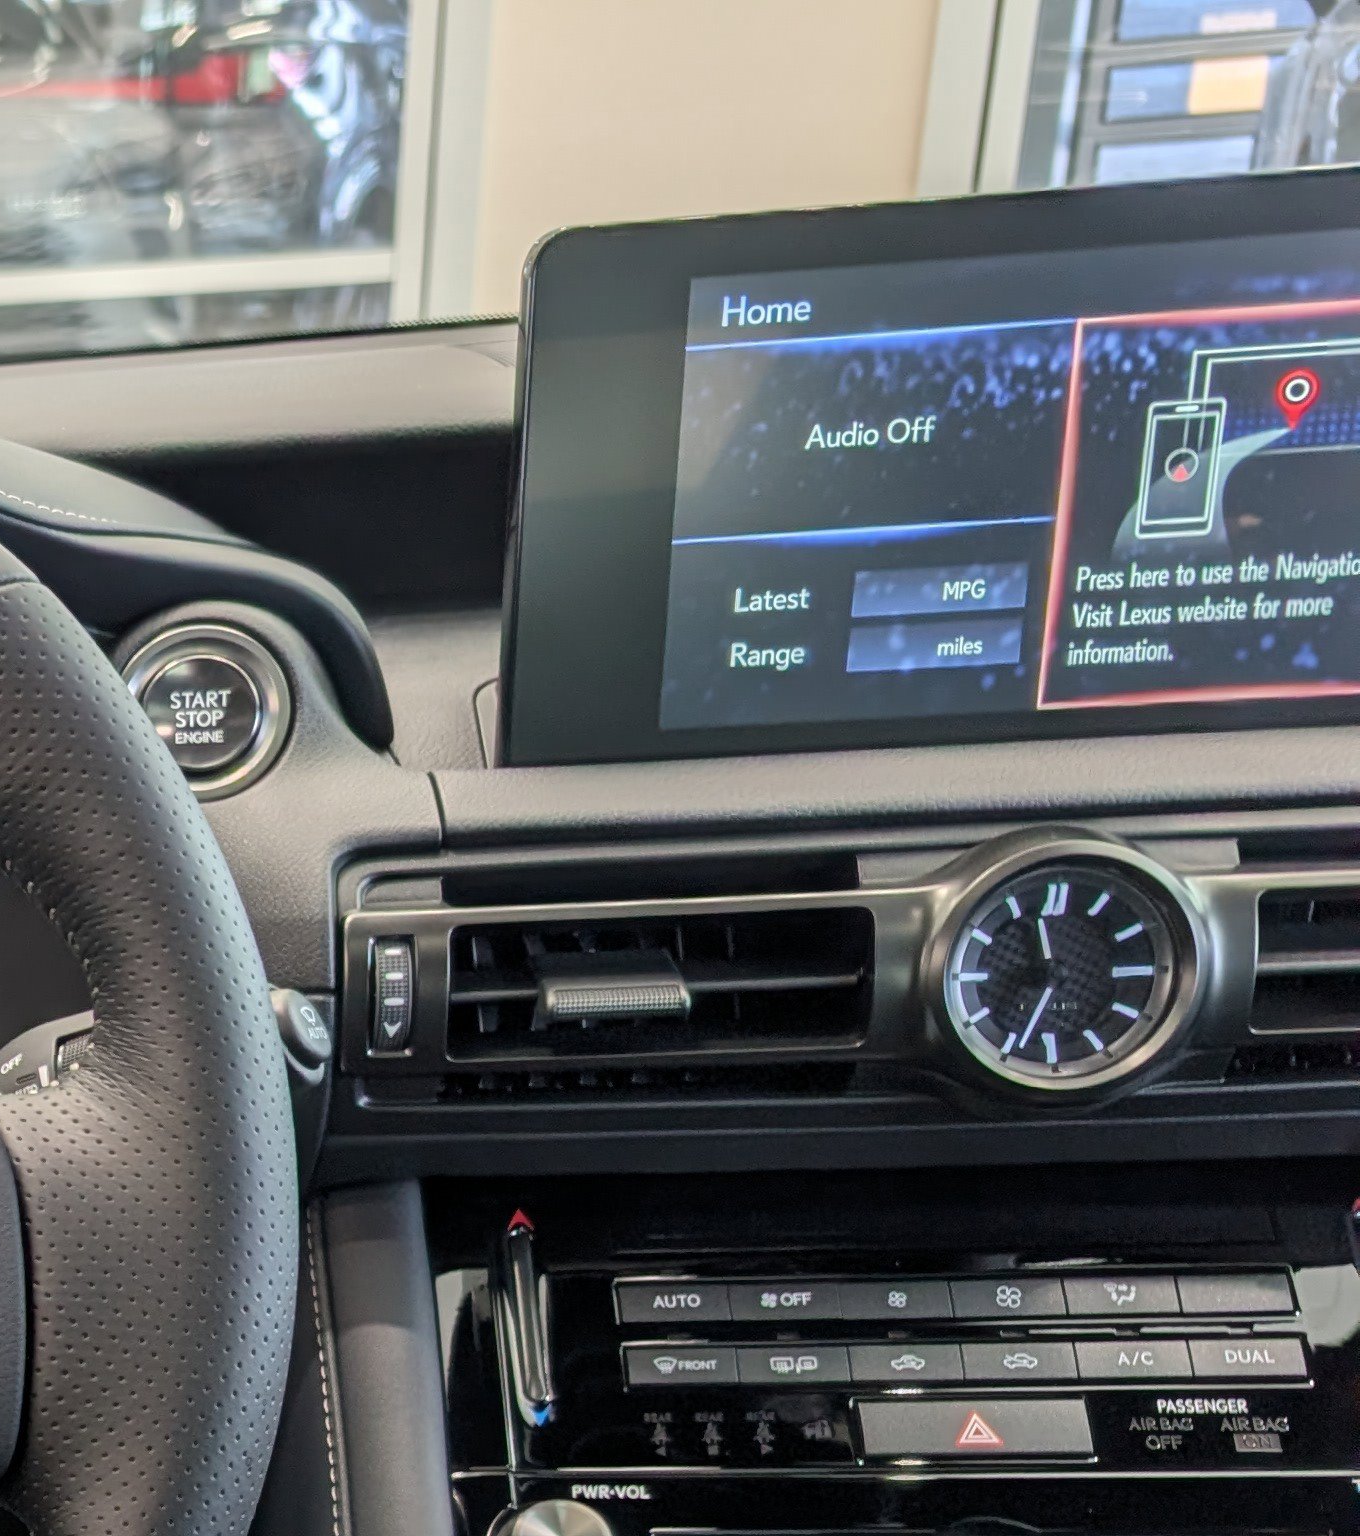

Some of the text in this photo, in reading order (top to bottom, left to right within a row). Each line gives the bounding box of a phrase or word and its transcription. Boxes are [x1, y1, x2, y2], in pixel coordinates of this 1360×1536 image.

[721, 295, 812, 327] Home
[804, 415, 938, 450] Audio Off
[1075, 565, 1124, 592] Press
[1129, 561, 1170, 588] here
[1175, 562, 1196, 586] to
[1201, 564, 1233, 585] use
[1239, 555, 1269, 582] the
[734, 579, 986, 613] Latest MPG
[1072, 592, 1333, 628] Visit Lexus website for more
[730, 635, 983, 671] Range miles
[1066, 638, 1175, 667] information.
[169, 689, 232, 710] START
[175, 710, 226, 729] STOP
[174, 729, 225, 745] ENGINE
[0, 1053, 23, 1075] OFF
[652, 1292, 701, 1310] AUTO
[780, 1290, 812, 1307] OFF
[677, 1357, 717, 1372] FRONT
[1117, 1350, 1155, 1366] A/C
[1224, 1348, 1276, 1365] DUAL
[1156, 1398, 1249, 1415] PASSENGER
[1145, 1434, 1183, 1451] OFF
